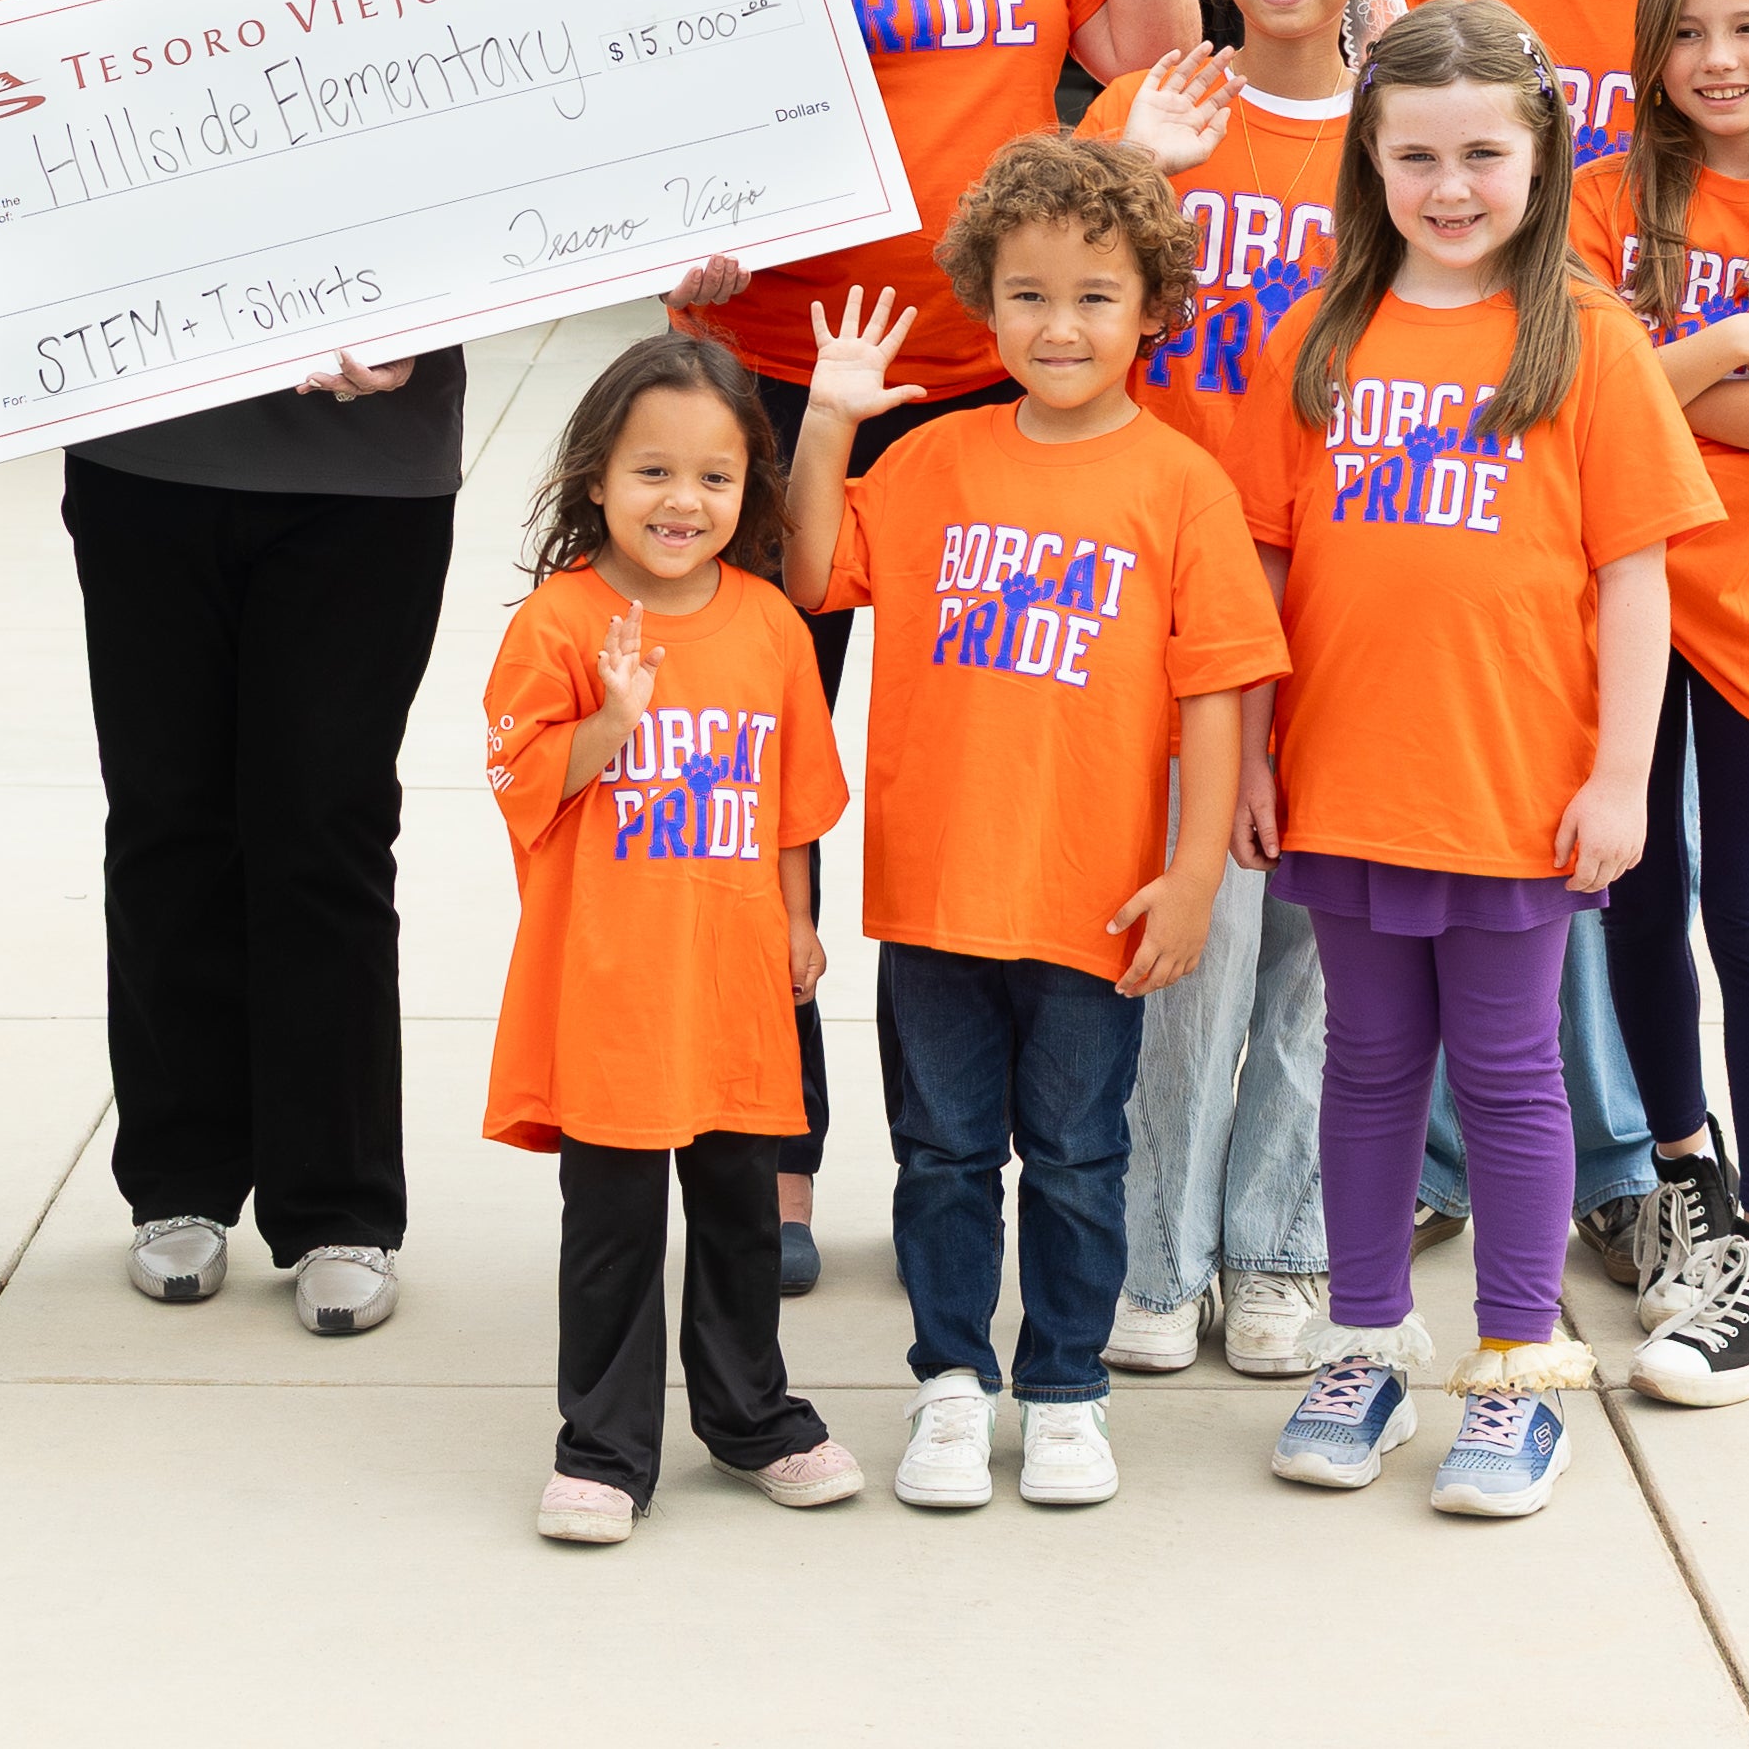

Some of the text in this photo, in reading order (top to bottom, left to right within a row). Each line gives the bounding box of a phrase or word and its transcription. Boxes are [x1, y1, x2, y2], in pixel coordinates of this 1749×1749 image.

[61, 19, 266, 90] TESORO
[33, 87, 258, 207] Hillside
[264, 20, 587, 146] Elementary
[775, 99, 830, 123] Dollars
[1, 197, 21, 209] the
[2, 393, 28, 409] For:
[37, 300, 177, 394] STEM
[1331, 452, 1509, 535] PRIDE
[935, 523, 1138, 619] BOBCAT
[932, 596, 1102, 688] PRIDE
[612, 785, 760, 860] PRIDE
